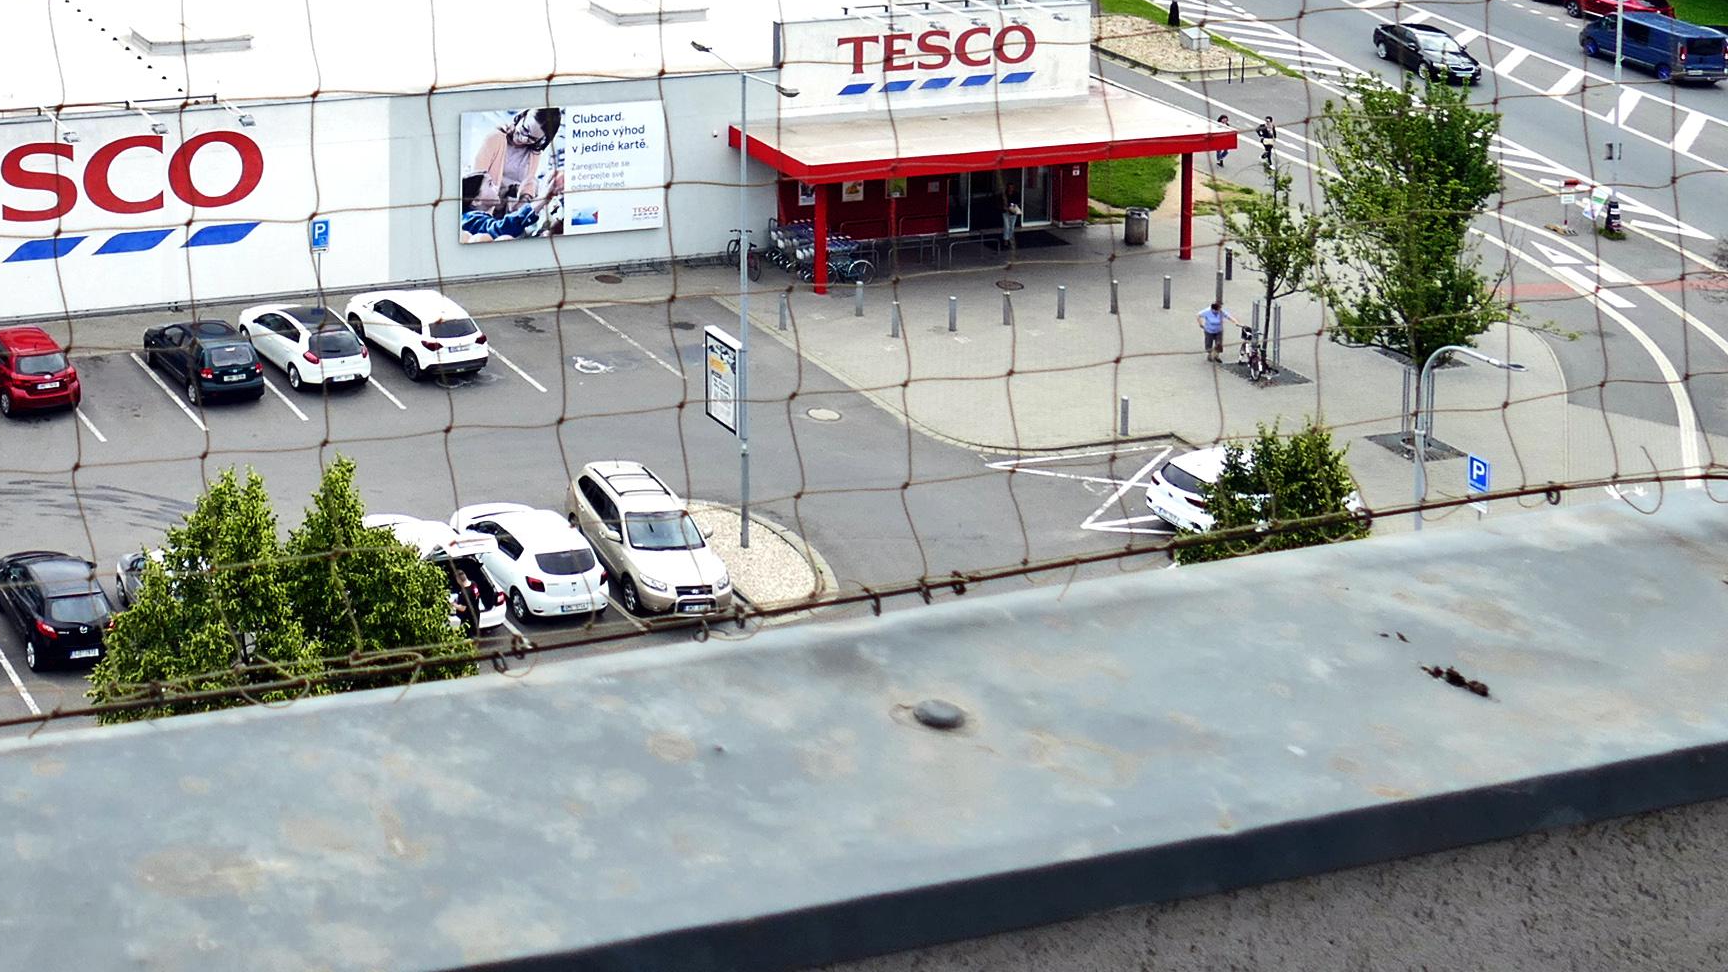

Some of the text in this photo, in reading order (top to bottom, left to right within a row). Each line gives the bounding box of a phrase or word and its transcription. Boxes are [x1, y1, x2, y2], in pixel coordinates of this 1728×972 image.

[838, 25, 1036, 74] TESCO
[572, 124, 645, 139] Mnoho výhod
[581, 141, 615, 155] jediné
[633, 205, 659, 213] TESCO
[315, 223, 327, 239] P
[1473, 460, 1485, 479] P
